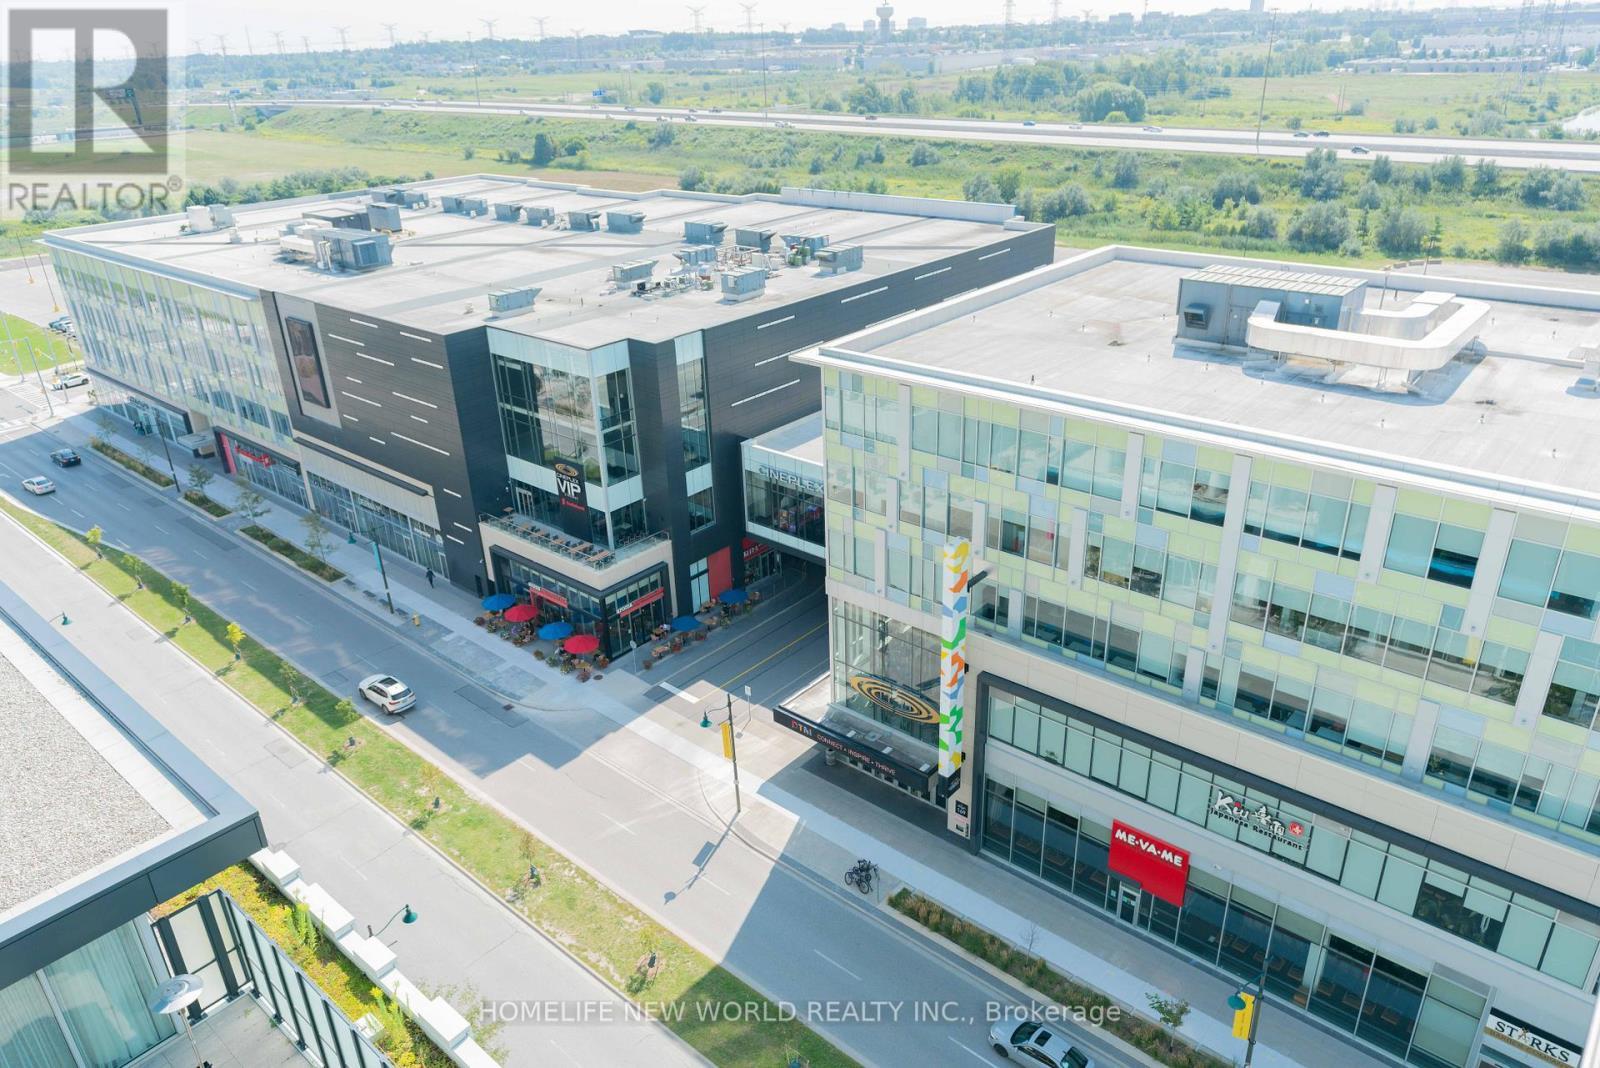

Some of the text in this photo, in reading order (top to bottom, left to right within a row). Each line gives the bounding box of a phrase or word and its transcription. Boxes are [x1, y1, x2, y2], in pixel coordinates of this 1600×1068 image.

[557, 478, 582, 497] VIP
[758, 465, 825, 493] CINEPLEX
[1252, 824, 1304, 850] Restaurant
